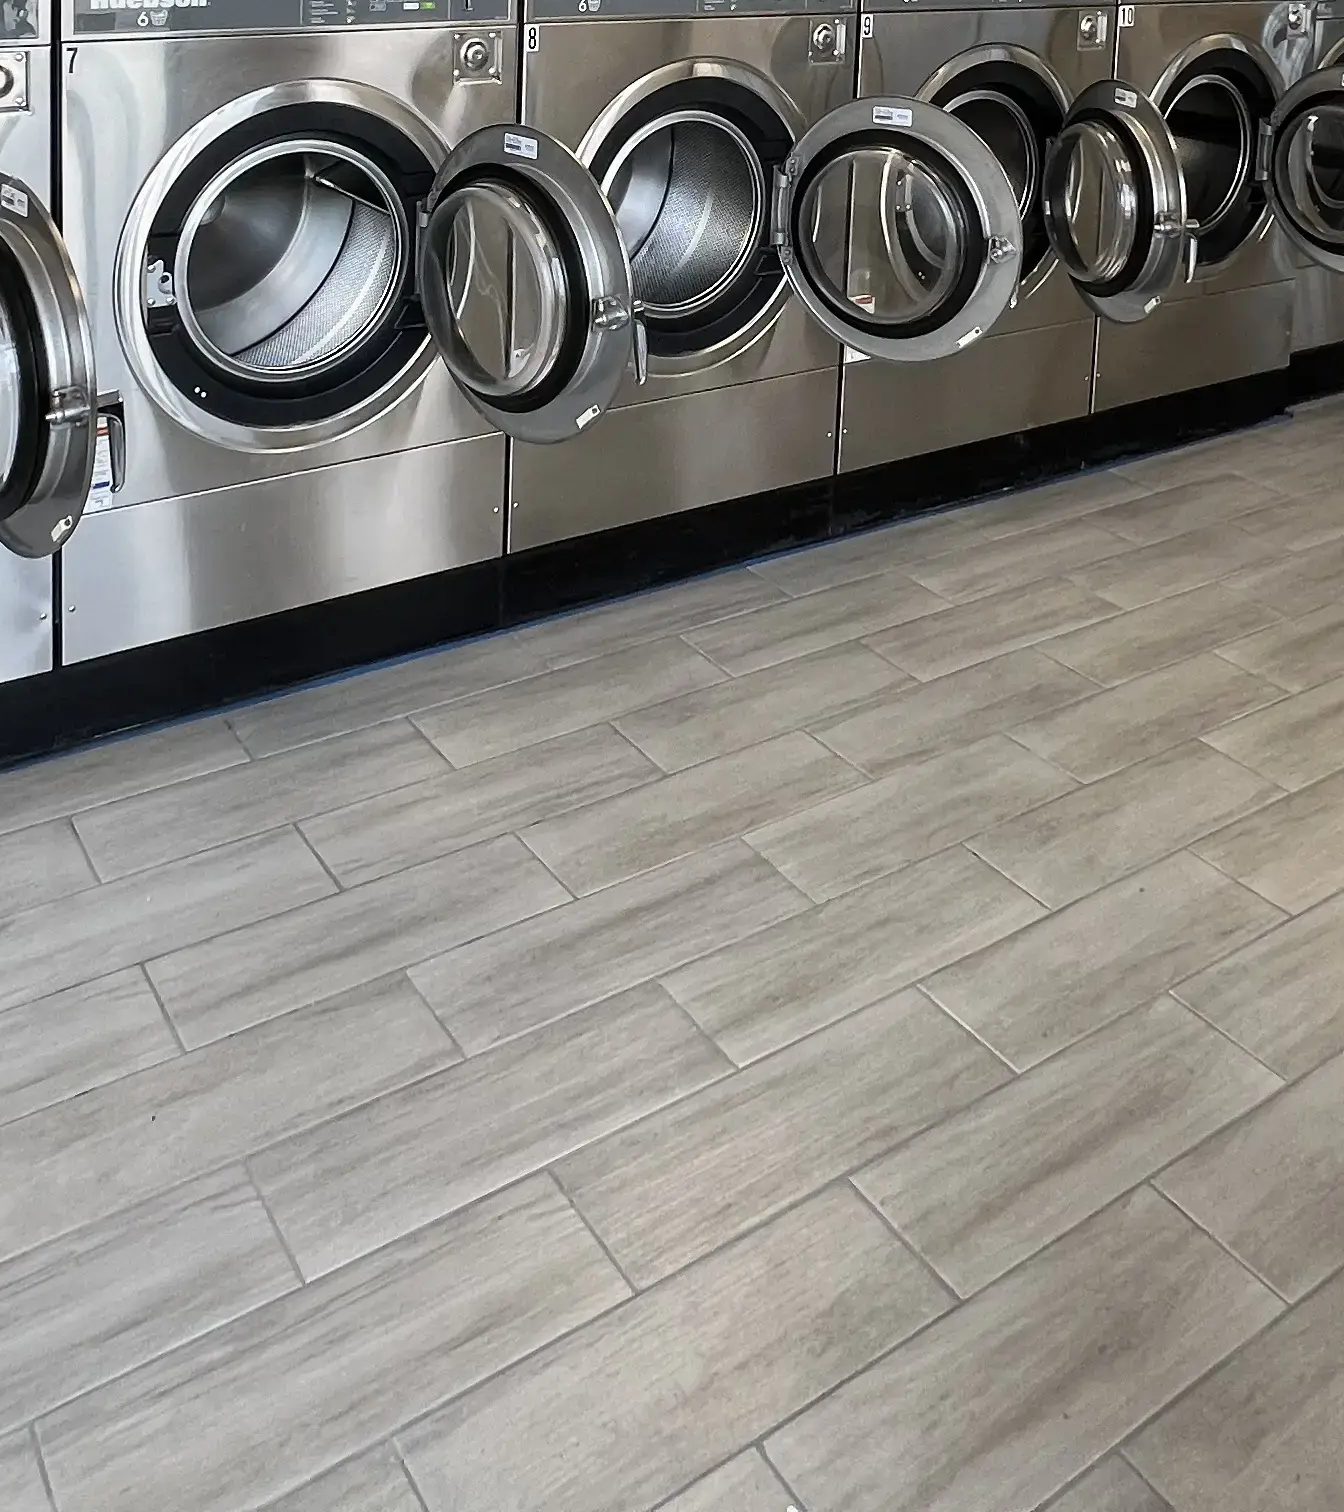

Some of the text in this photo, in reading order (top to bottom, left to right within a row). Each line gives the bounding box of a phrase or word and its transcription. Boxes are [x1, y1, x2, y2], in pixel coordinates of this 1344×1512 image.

[137, 11, 149, 27] 6
[863, 16, 871, 36] 9
[1121, 7, 1133, 25] 10
[528, 27, 537, 49] 8
[66, 47, 78, 73] 7
